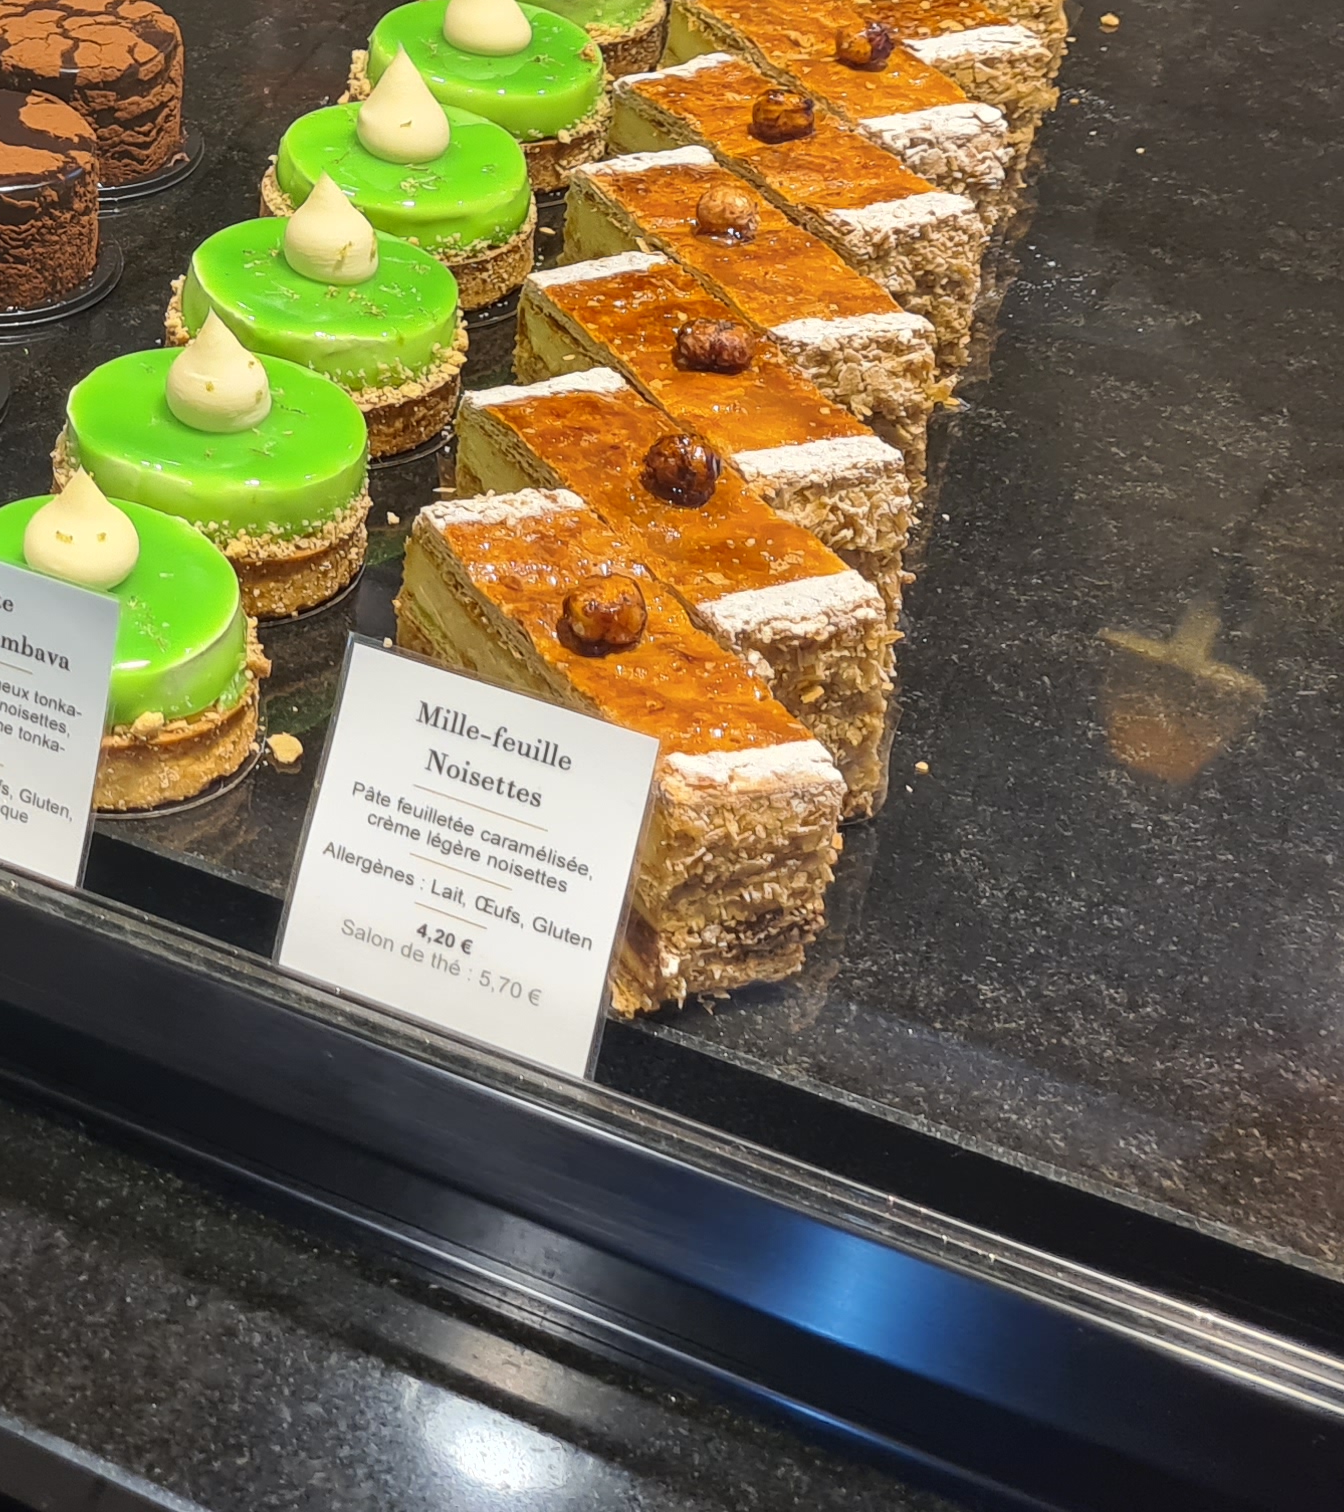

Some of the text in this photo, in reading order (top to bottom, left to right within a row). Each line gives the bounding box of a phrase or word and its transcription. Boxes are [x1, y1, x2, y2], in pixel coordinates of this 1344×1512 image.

[34, 690, 82, 717] tonka-
[416, 700, 571, 770] Mille-feuille
[18, 726, 65, 752] tonka-
[19, 788, 72, 822] Gluten,
[425, 749, 541, 807] Noisettes
[352, 781, 592, 880] Pâte feuilletée caramélisée,
[367, 813, 567, 892] crème légère noisettes
[322, 841, 592, 950] Allergènes Lait, Œufs, Gluten
[341, 919, 394, 952] Salon
[400, 942, 424, 962] de
[430, 952, 460, 976] thé
[478, 969, 522, 998] 5,70
[416, 923, 455, 948] 4,20
